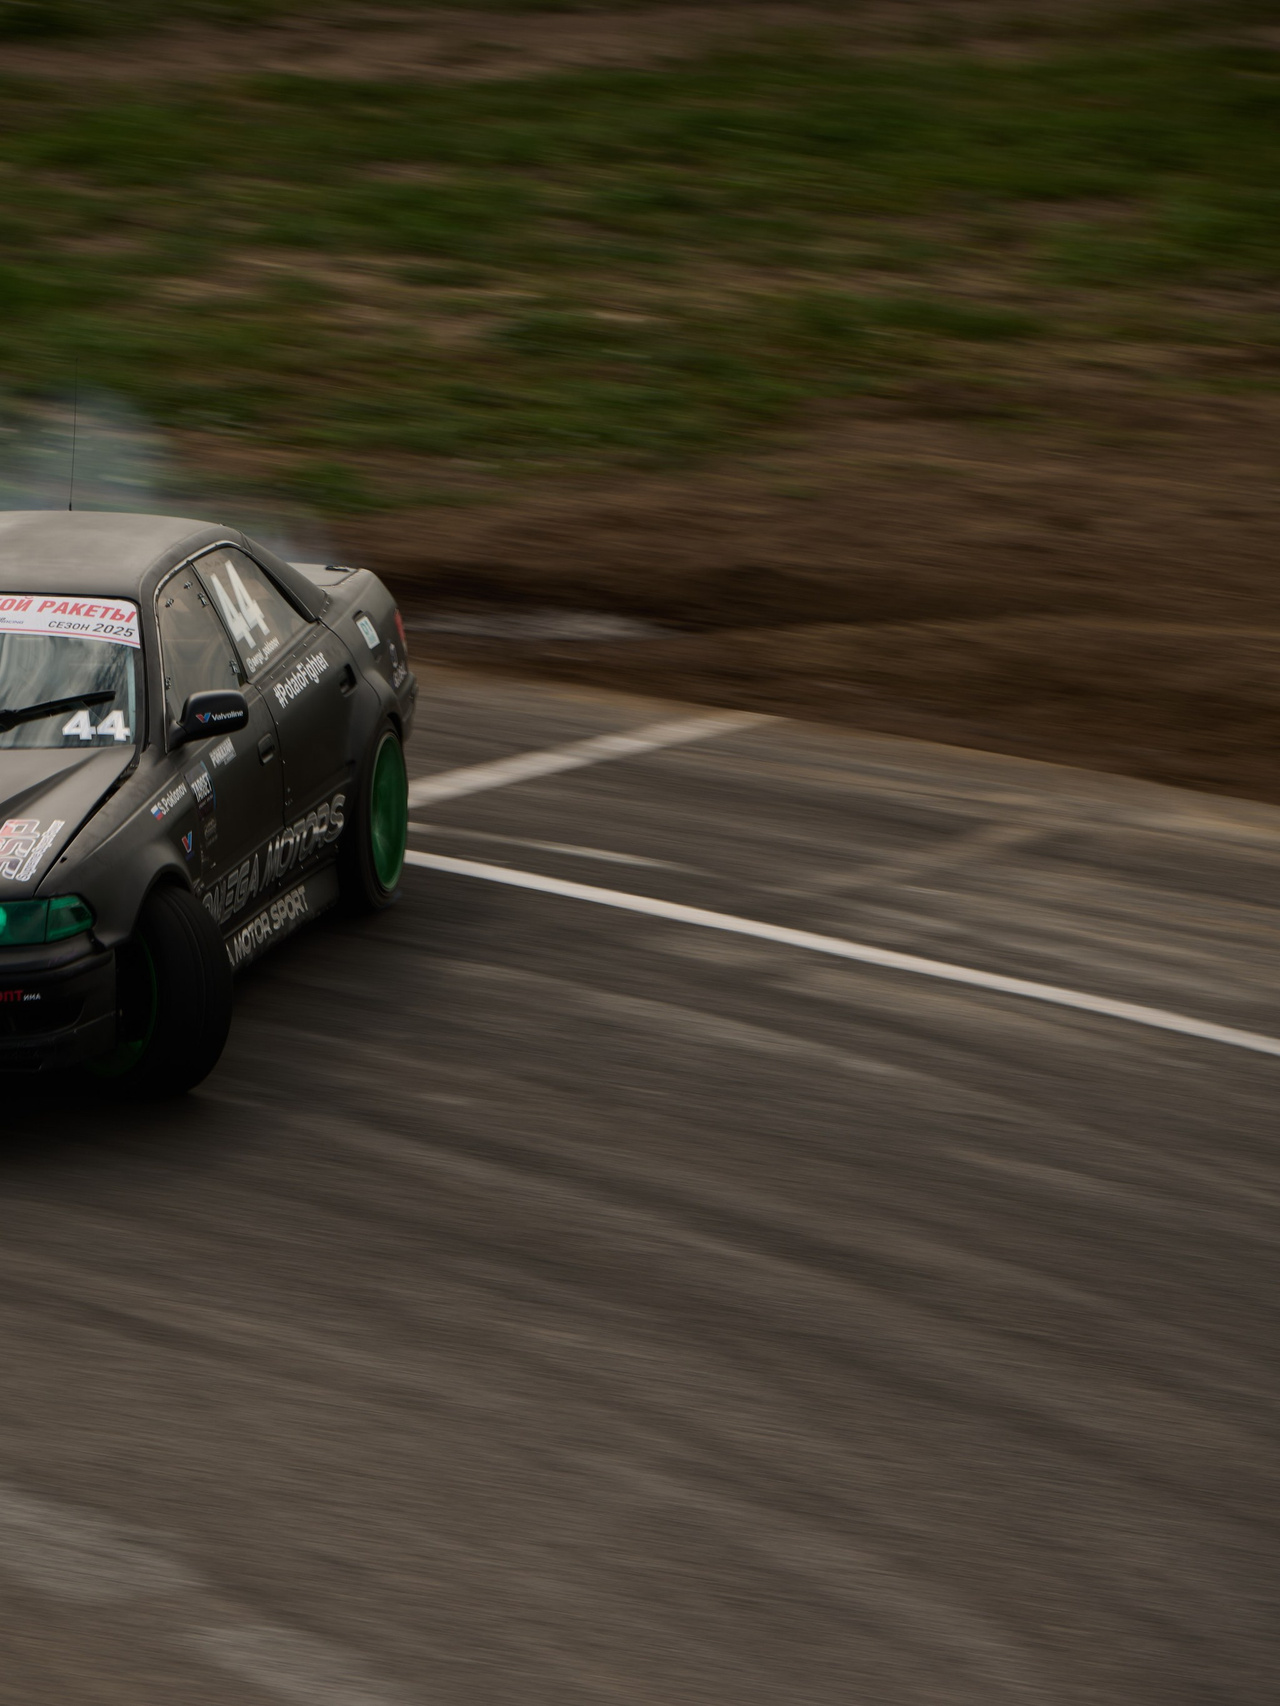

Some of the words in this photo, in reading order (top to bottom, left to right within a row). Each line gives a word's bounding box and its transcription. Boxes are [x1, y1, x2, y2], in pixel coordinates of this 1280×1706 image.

[36, 600, 138, 624] РАКЕТЫ
[210, 560, 270, 649] 44
[48, 620, 91, 631] СЕЗОН
[92, 623, 136, 638] 2025
[273, 651, 330, 709] #PotatoFighter
[62, 709, 131, 741] 44
[211, 710, 244, 721] Valvoline
[259, 793, 346, 892] MOTORS
[233, 911, 272, 964] MOTOR
[271, 885, 309, 930] SPORT
